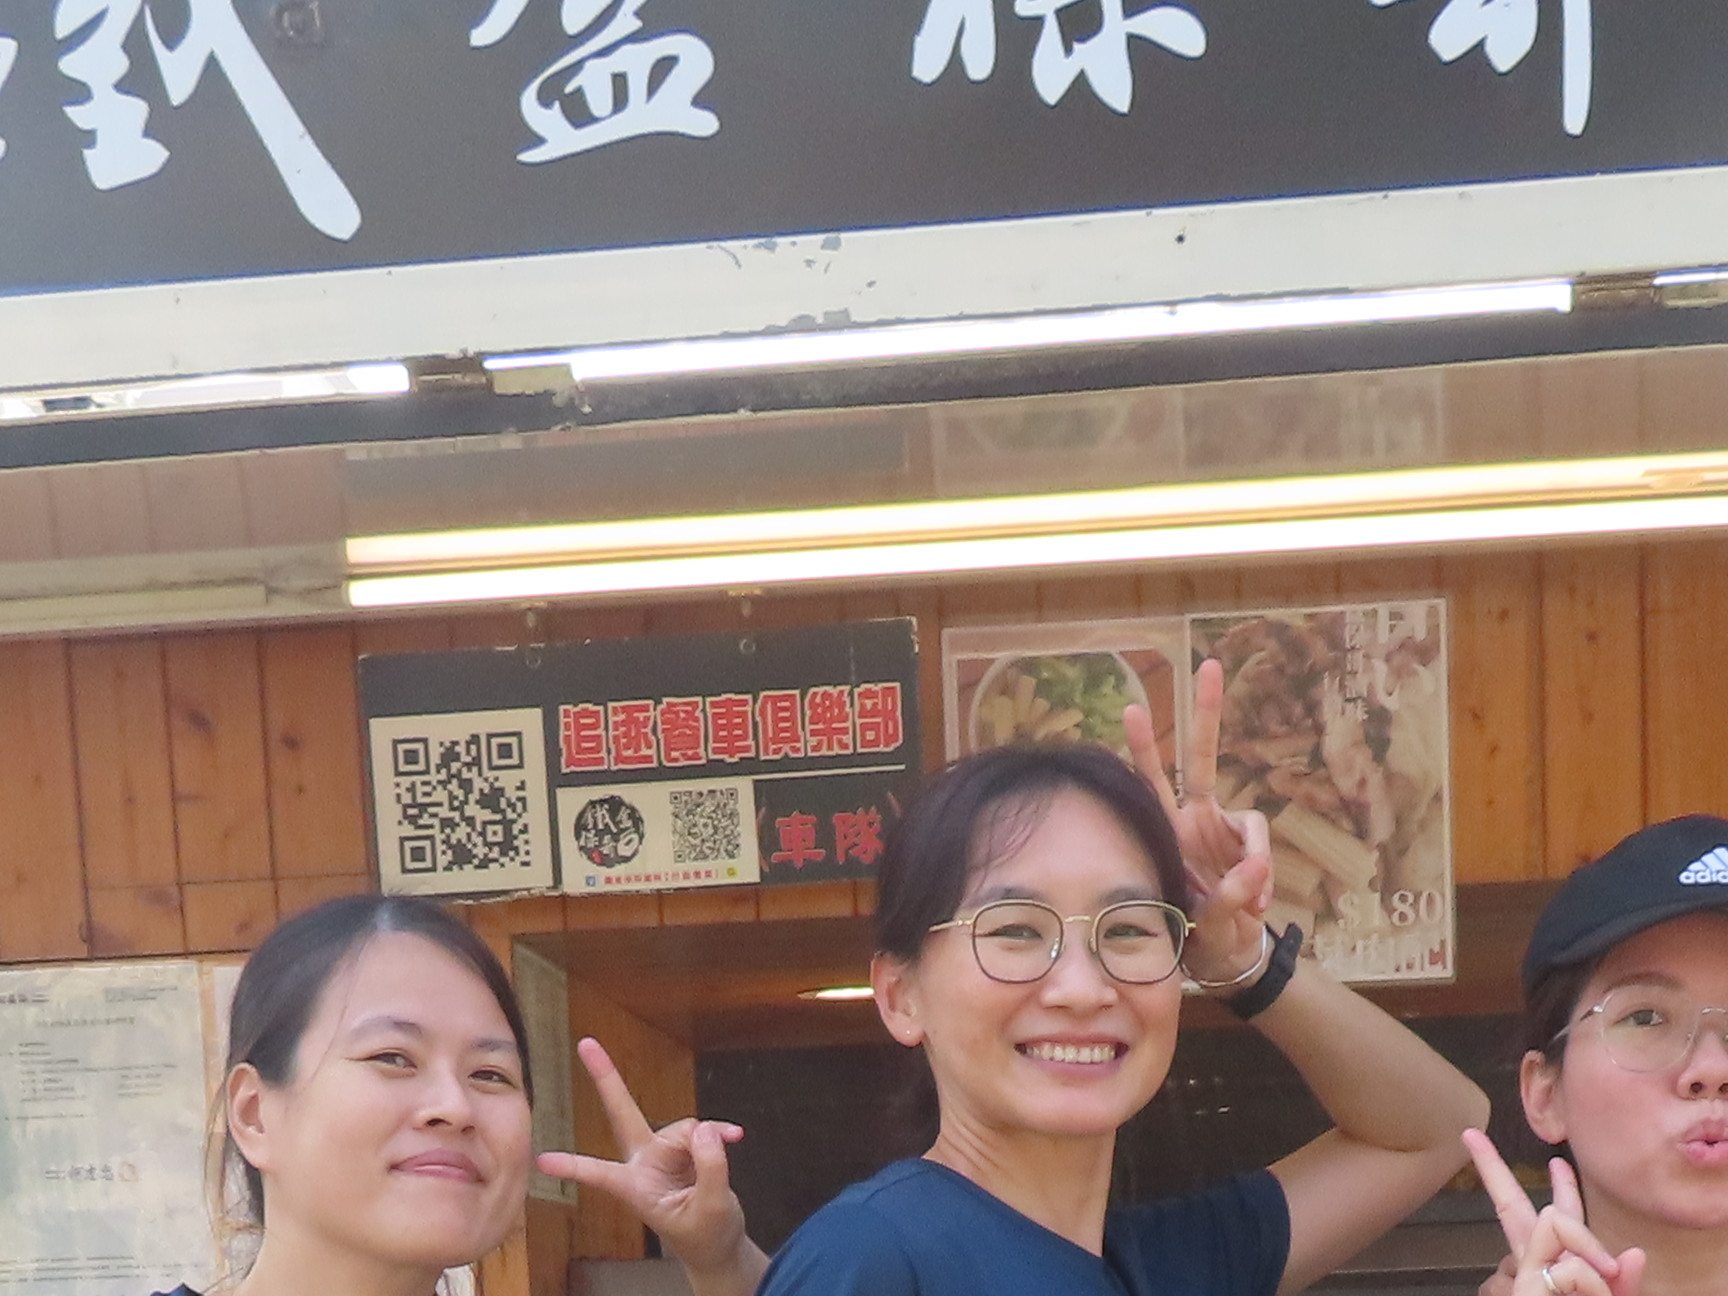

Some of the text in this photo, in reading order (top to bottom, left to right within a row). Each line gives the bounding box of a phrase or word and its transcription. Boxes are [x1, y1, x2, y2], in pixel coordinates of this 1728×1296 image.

[559, 683, 903, 773] 追逐餐車俱樂部
[1337, 889, 1444, 934] $180
